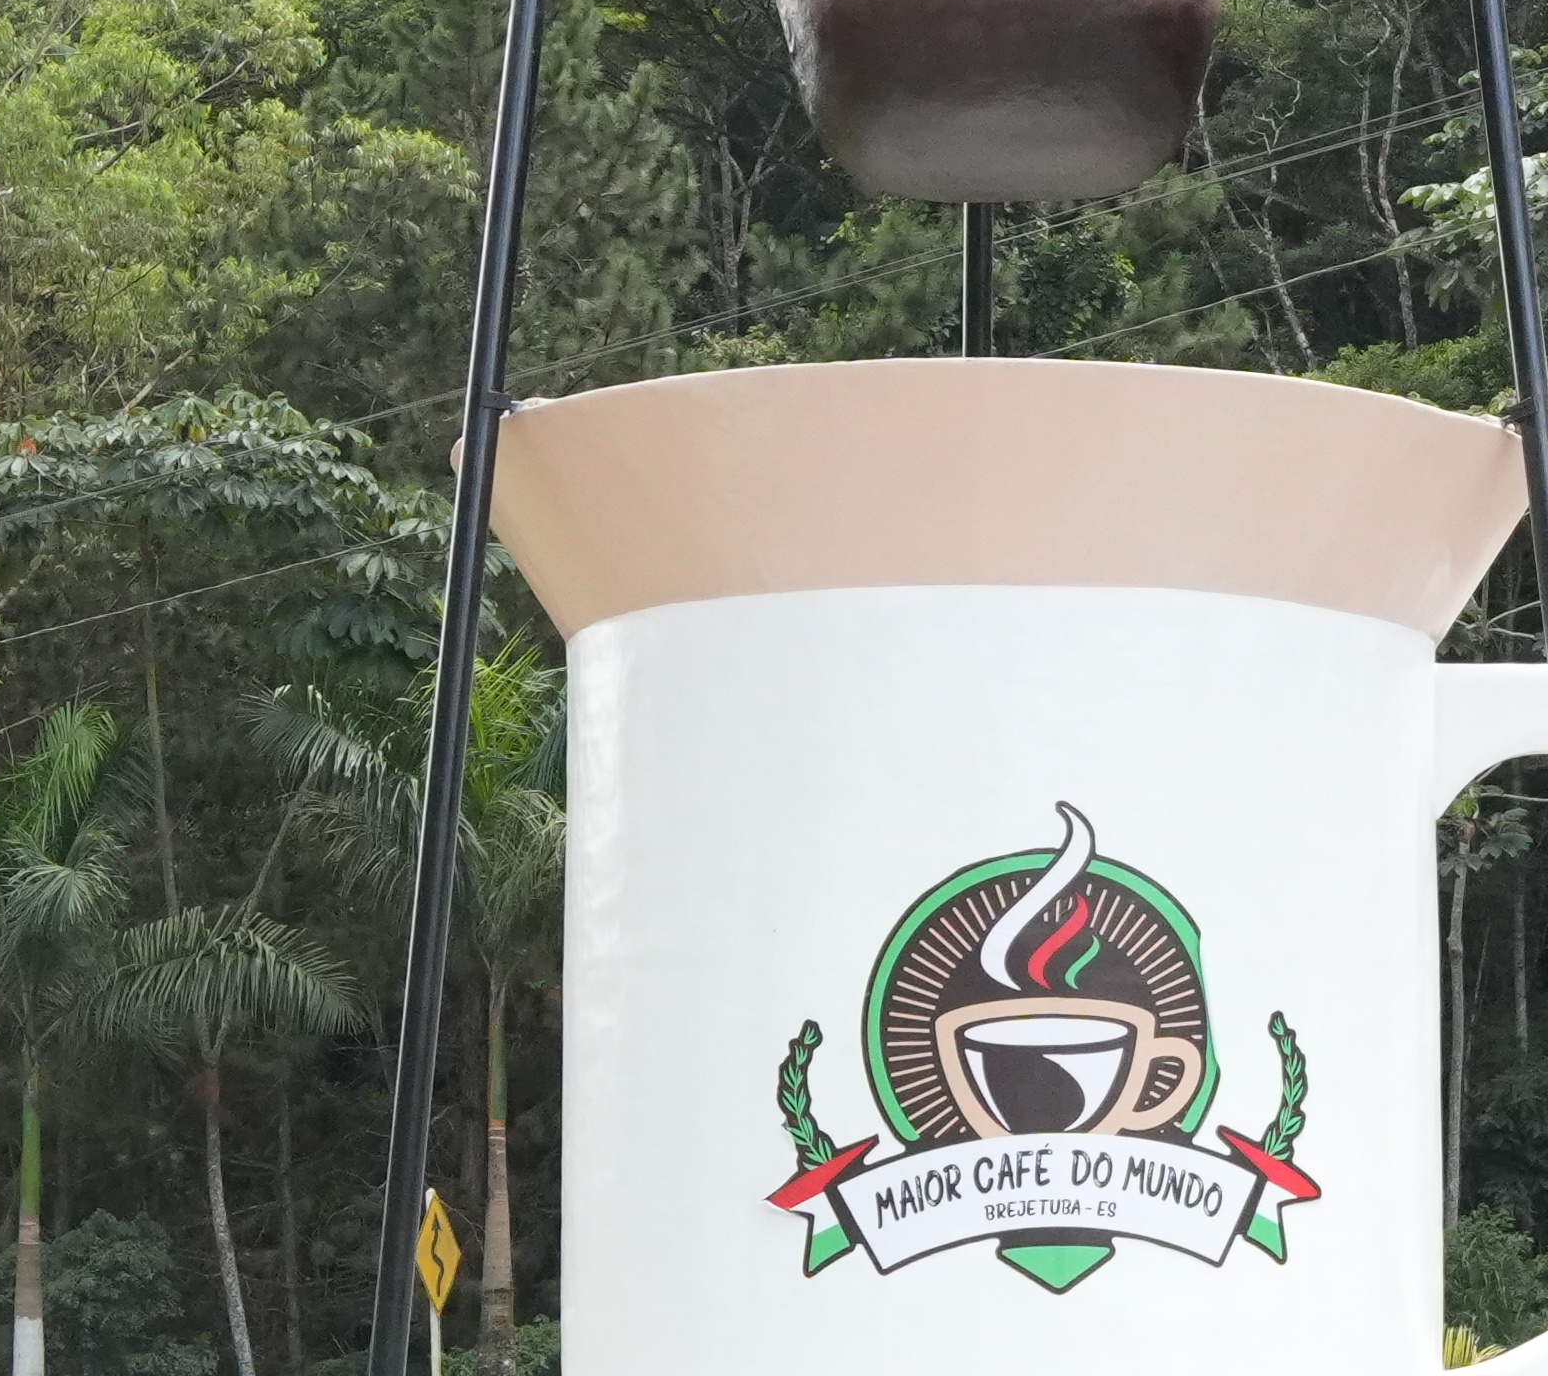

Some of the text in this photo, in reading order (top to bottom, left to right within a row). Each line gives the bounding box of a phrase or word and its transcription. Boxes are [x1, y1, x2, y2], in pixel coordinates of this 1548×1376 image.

[875, 1143, 1223, 1229] MAIOR CAFÉ DO MUNDO
[984, 1199, 1081, 1221] BREJETUBA
[1097, 1201, 1117, 1218] ES
